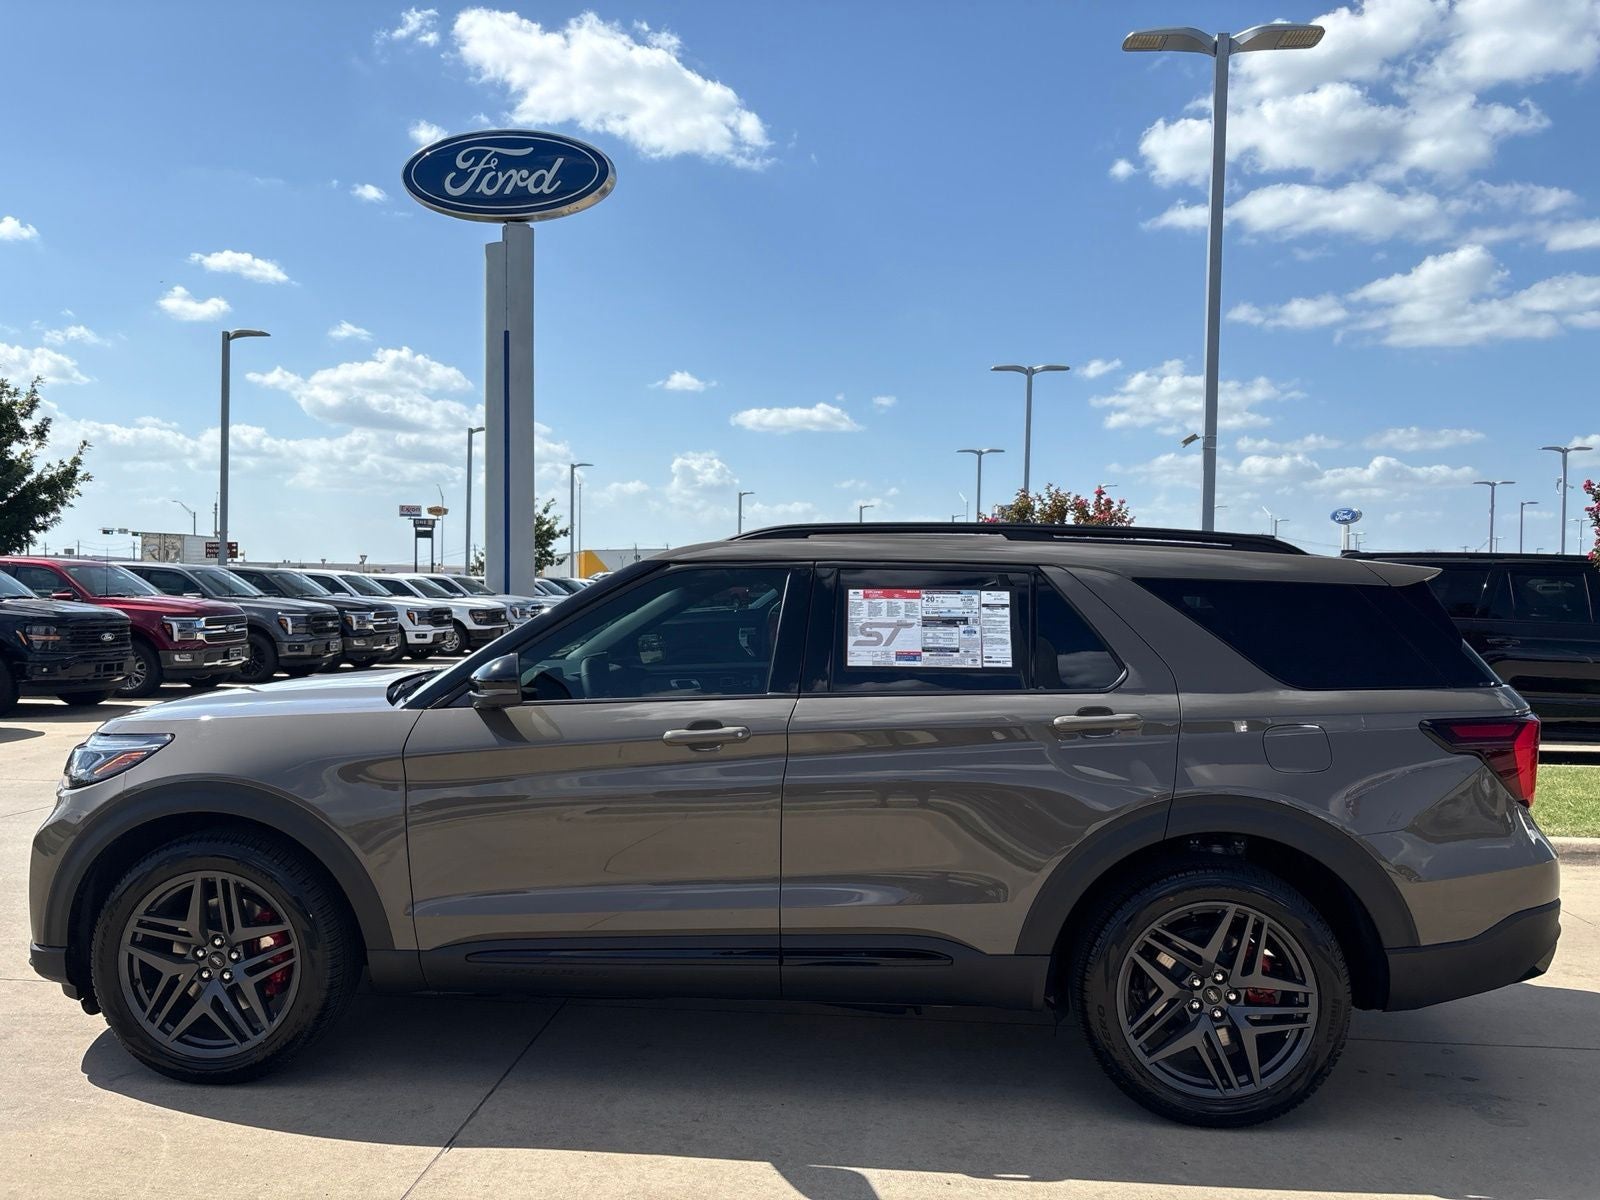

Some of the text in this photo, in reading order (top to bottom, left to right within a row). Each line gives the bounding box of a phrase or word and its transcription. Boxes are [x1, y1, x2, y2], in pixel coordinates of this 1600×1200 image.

[444, 146, 564, 196] Ford
[1335, 510, 1352, 521] Ford
[853, 621, 916, 646] ST
